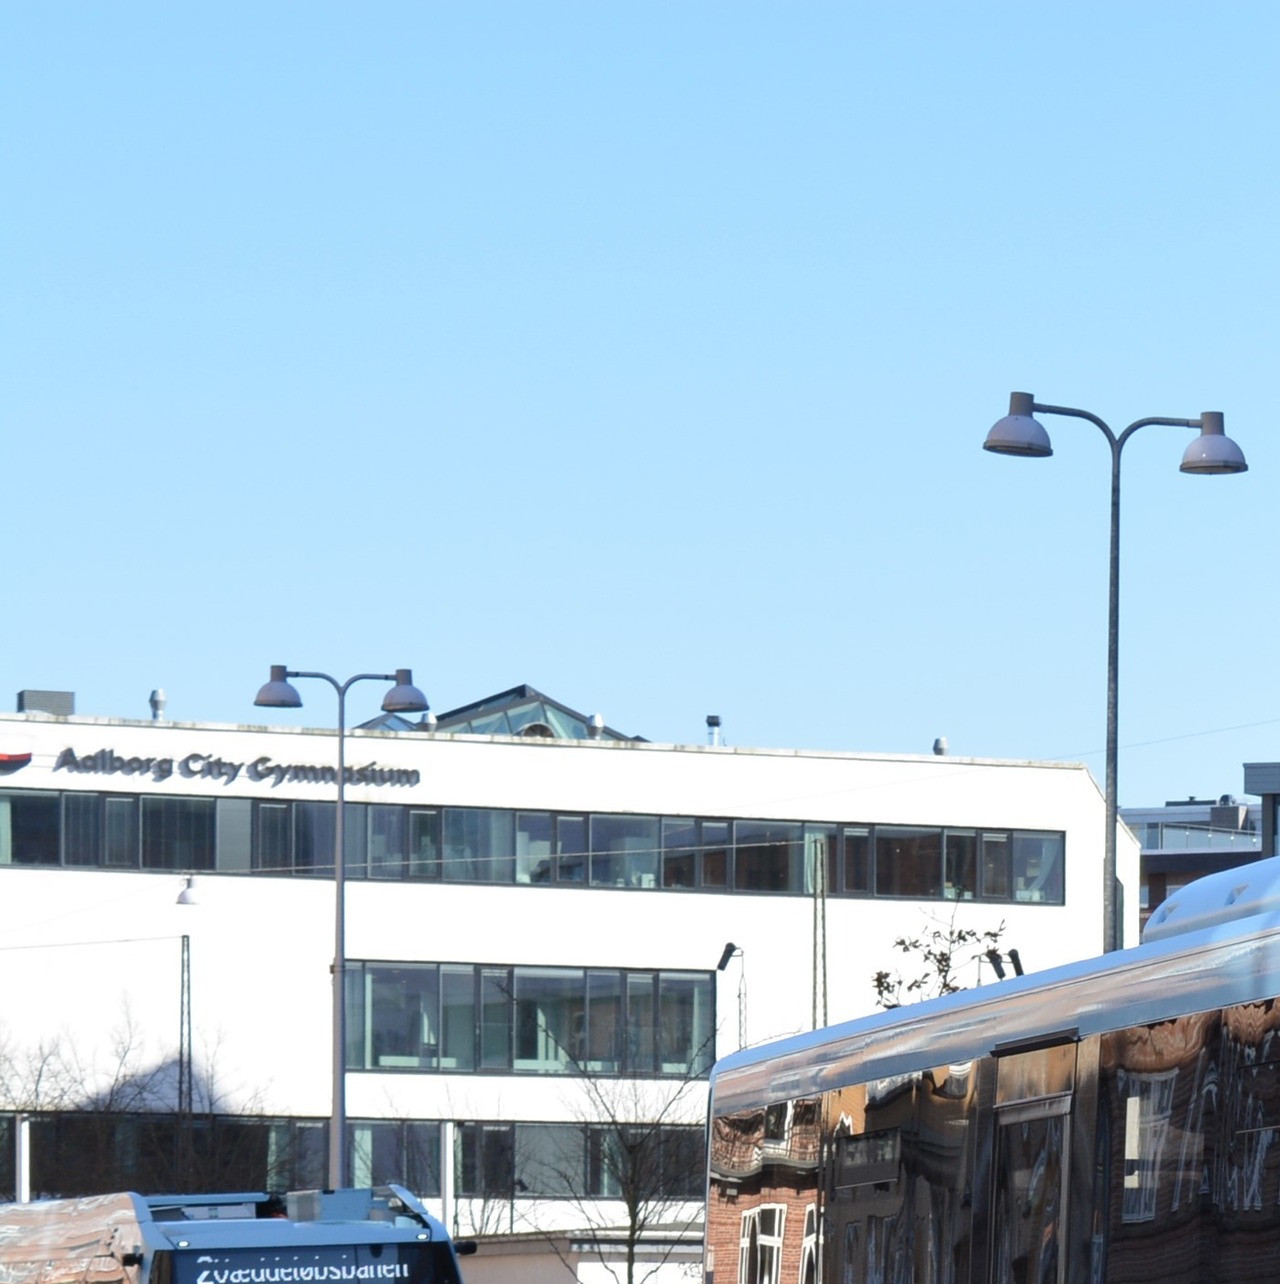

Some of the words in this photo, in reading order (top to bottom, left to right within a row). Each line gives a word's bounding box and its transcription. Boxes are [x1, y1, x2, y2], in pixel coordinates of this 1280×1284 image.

[53, 747, 173, 781] Aalborg
[178, 753, 243, 785] City
[246, 756, 420, 788] Gymnasium
